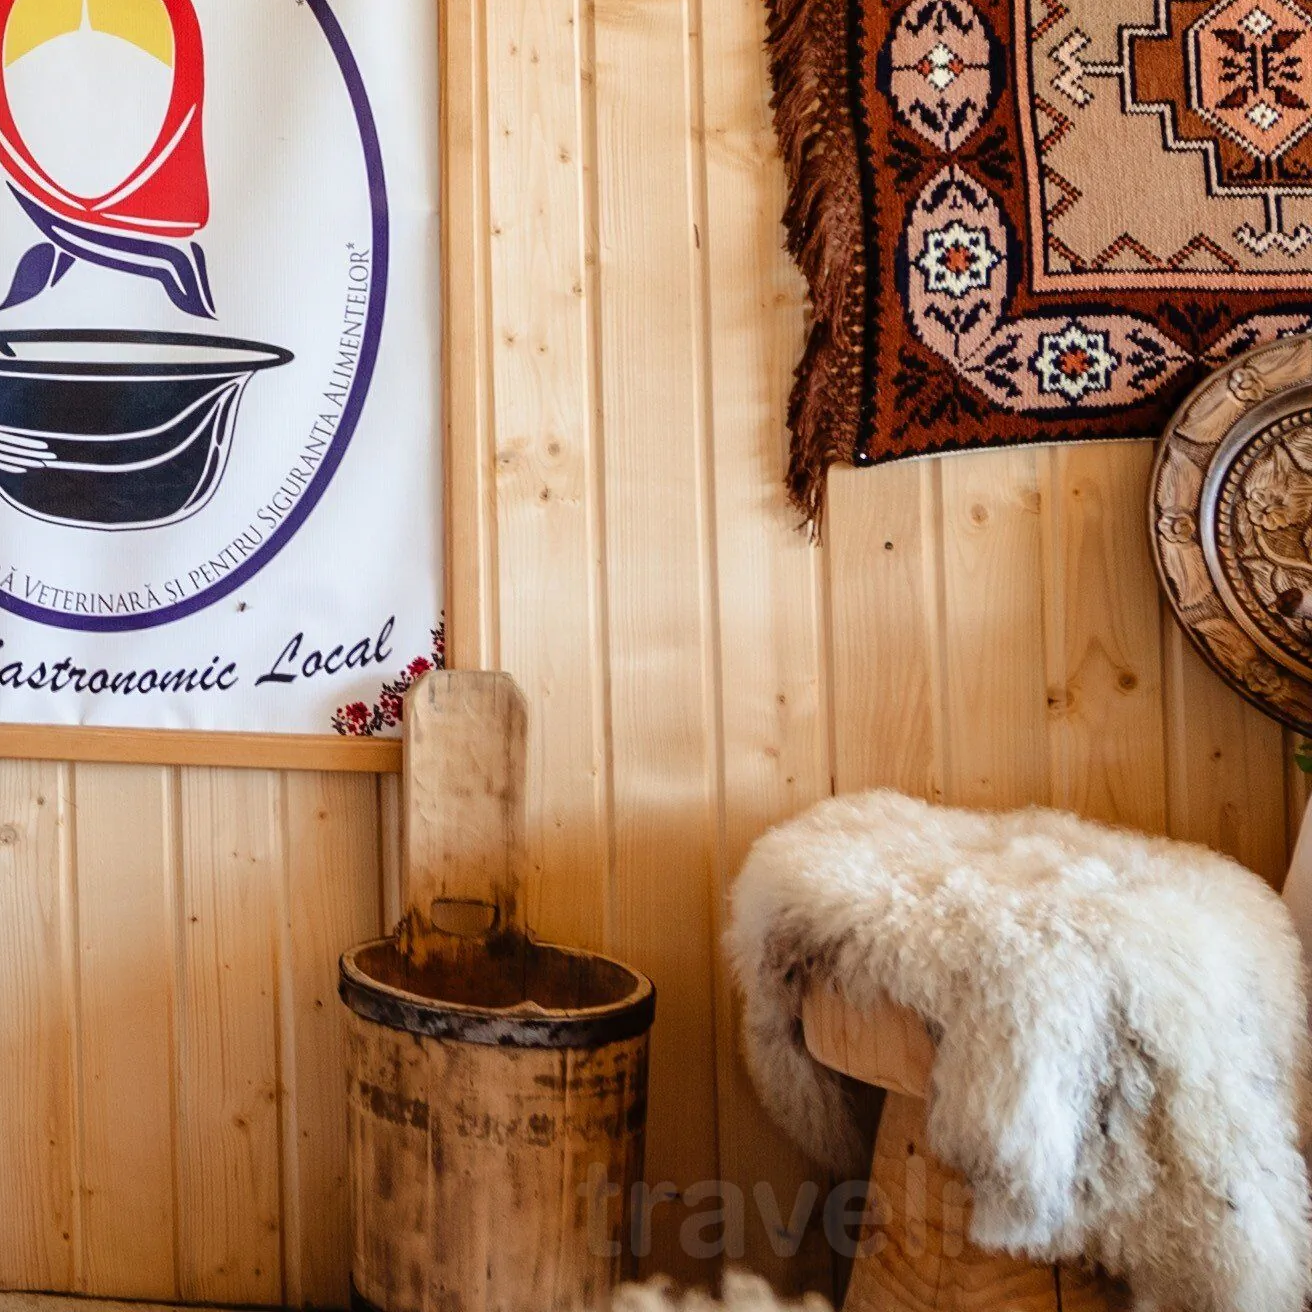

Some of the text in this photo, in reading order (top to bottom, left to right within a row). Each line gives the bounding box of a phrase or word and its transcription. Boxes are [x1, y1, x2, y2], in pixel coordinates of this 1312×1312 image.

[24, 574, 162, 614] VETERINARĂ
[188, 524, 264, 590] PENTRU
[254, 615, 396, 687] Local
